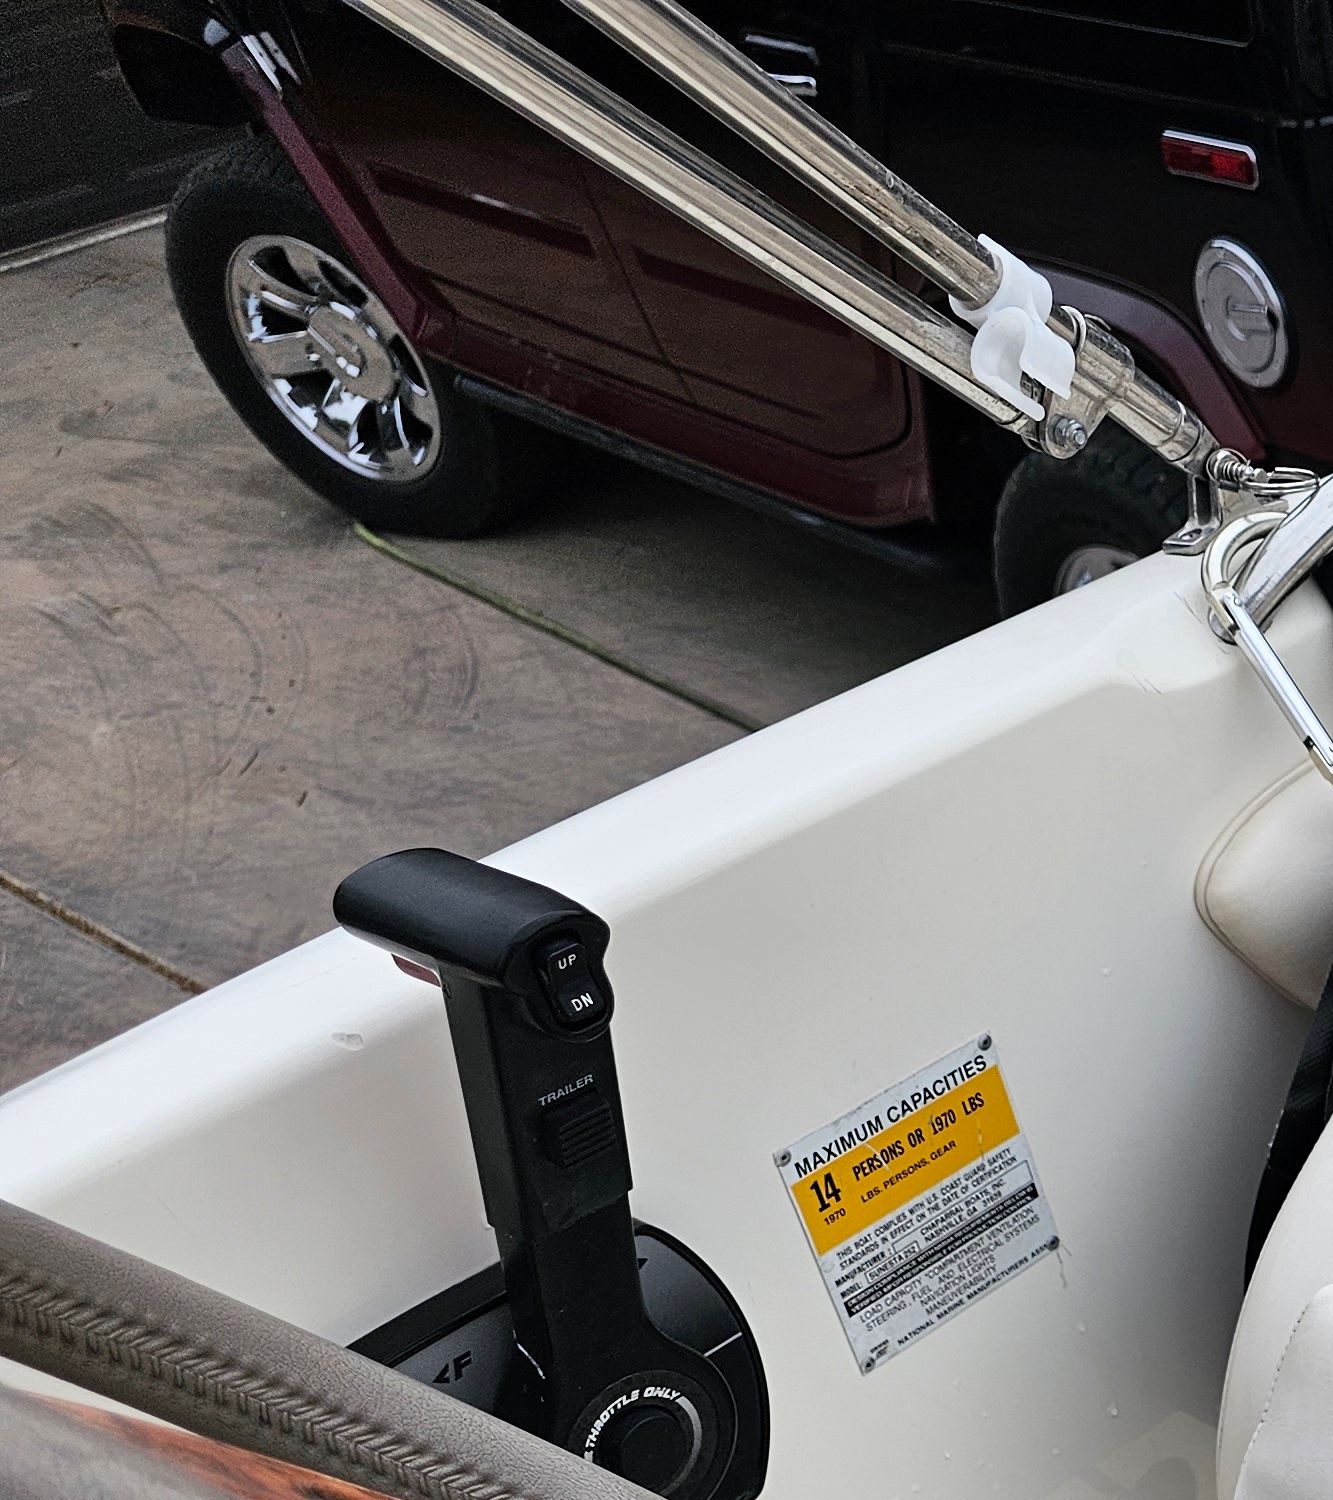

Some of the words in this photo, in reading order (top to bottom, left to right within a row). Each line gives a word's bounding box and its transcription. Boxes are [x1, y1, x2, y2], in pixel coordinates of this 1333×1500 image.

[558, 953, 577, 970] UP
[571, 992, 594, 1012] DN
[537, 1074, 594, 1106] TRAILER
[793, 1114, 883, 1178] MAXIMUM
[885, 1053, 987, 1124] CAPACITIES
[808, 1170, 844, 1213] 14
[851, 1138, 905, 1181] PERSONS
[906, 1126, 925, 1149] OR
[928, 1107, 957, 1135] 1970
[961, 1090, 985, 1116] LBS
[823, 1206, 846, 1226] 1970
[929, 1139, 956, 1161] GEAR
[836, 1244, 853, 1261] THIS
[853, 1232, 873, 1250] BOAT
[873, 1211, 907, 1238] COMPLIES
[908, 1200, 925, 1216] WITH
[940, 1176, 962, 1196] COAST
[839, 1240, 879, 1271] STANDARDS
[880, 1234, 889, 1246] IN
[889, 1218, 914, 1240] EFFECT
[915, 1210, 927, 1223] ON
[927, 1201, 941, 1216] THE
[941, 1190, 959, 1207] DATE
[961, 1183, 970, 1195] OF
[937, 1268, 955, 1286] AND
[1004, 1212, 1040, 1243] SYSTEMS
[859, 1302, 884, 1324] LOAD
[884, 1276, 923, 1308] CAPACITY
[454, 1351, 472, 1381] F
[585, 1389, 640, 1448] THROTTLE
[643, 1387, 681, 1401] ONLY
